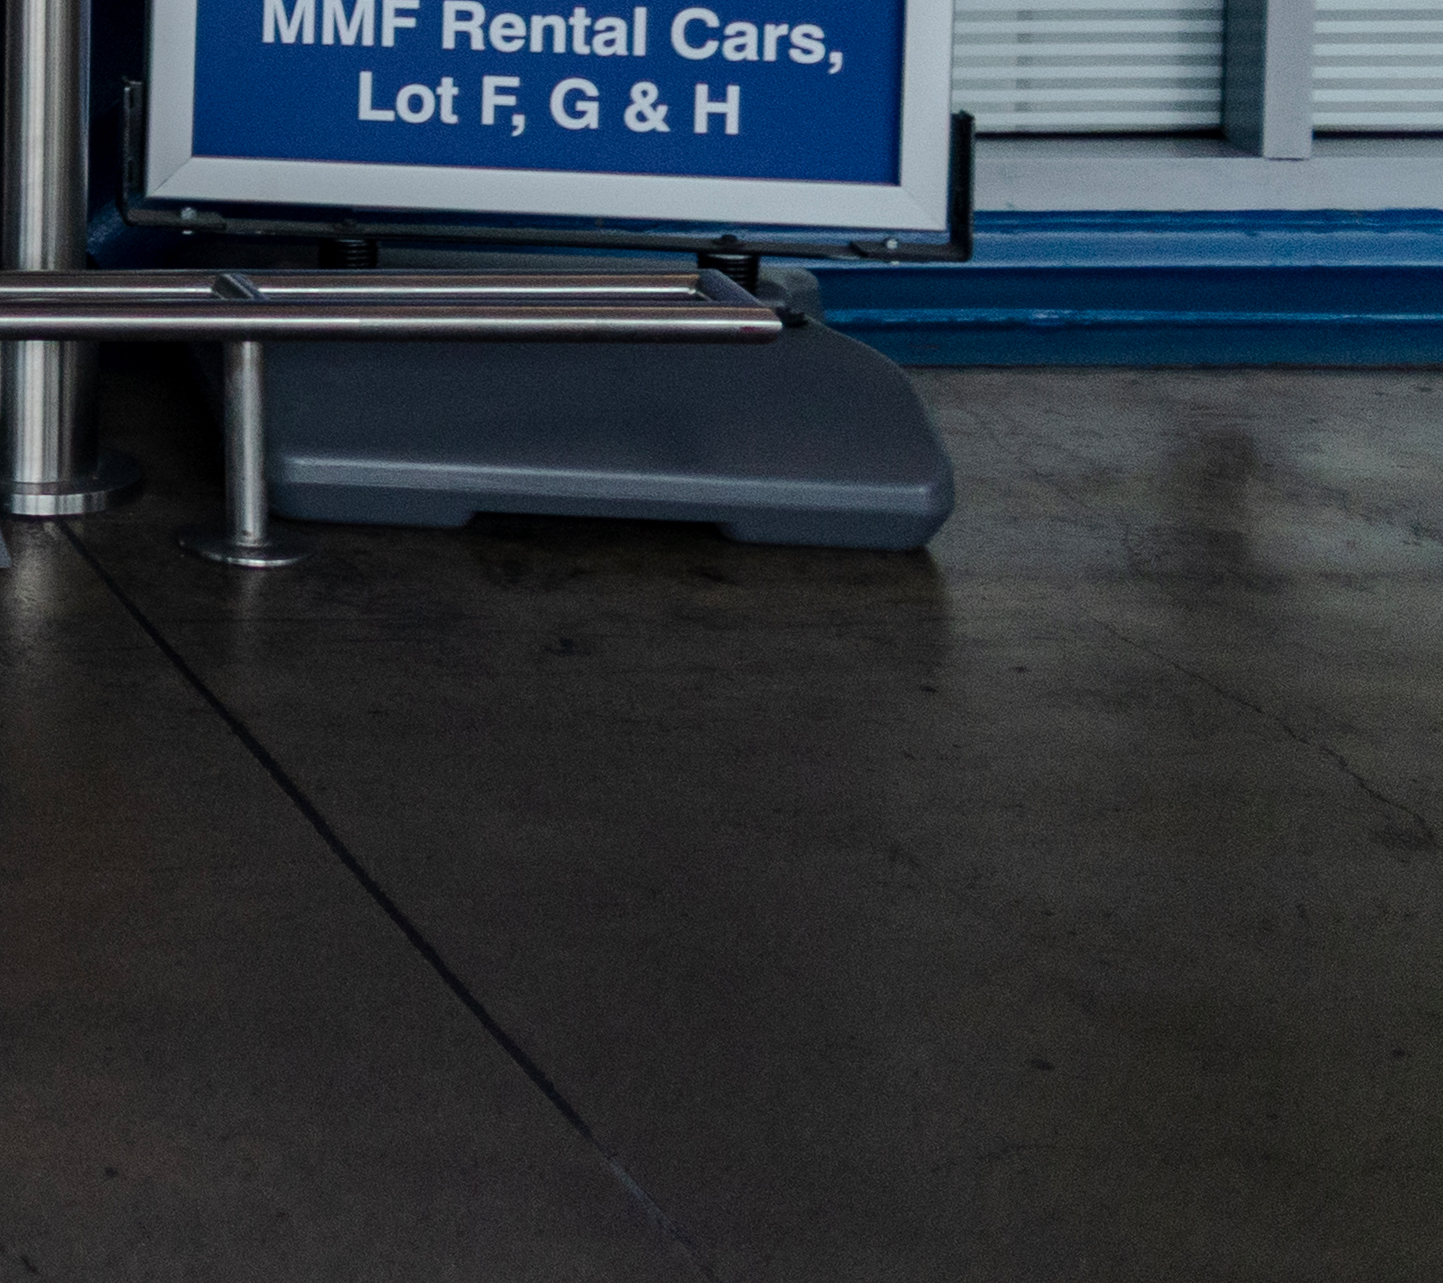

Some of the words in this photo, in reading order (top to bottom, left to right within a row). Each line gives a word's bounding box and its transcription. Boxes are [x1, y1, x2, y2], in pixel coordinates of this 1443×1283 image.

[443, 0, 646, 55] Rental
[671, 8, 842, 73] Cars,
[359, 71, 458, 123] Lot
[482, 76, 524, 136] F,
[551, 78, 598, 129] G
[625, 82, 669, 131] &
[695, 84, 739, 134] H
